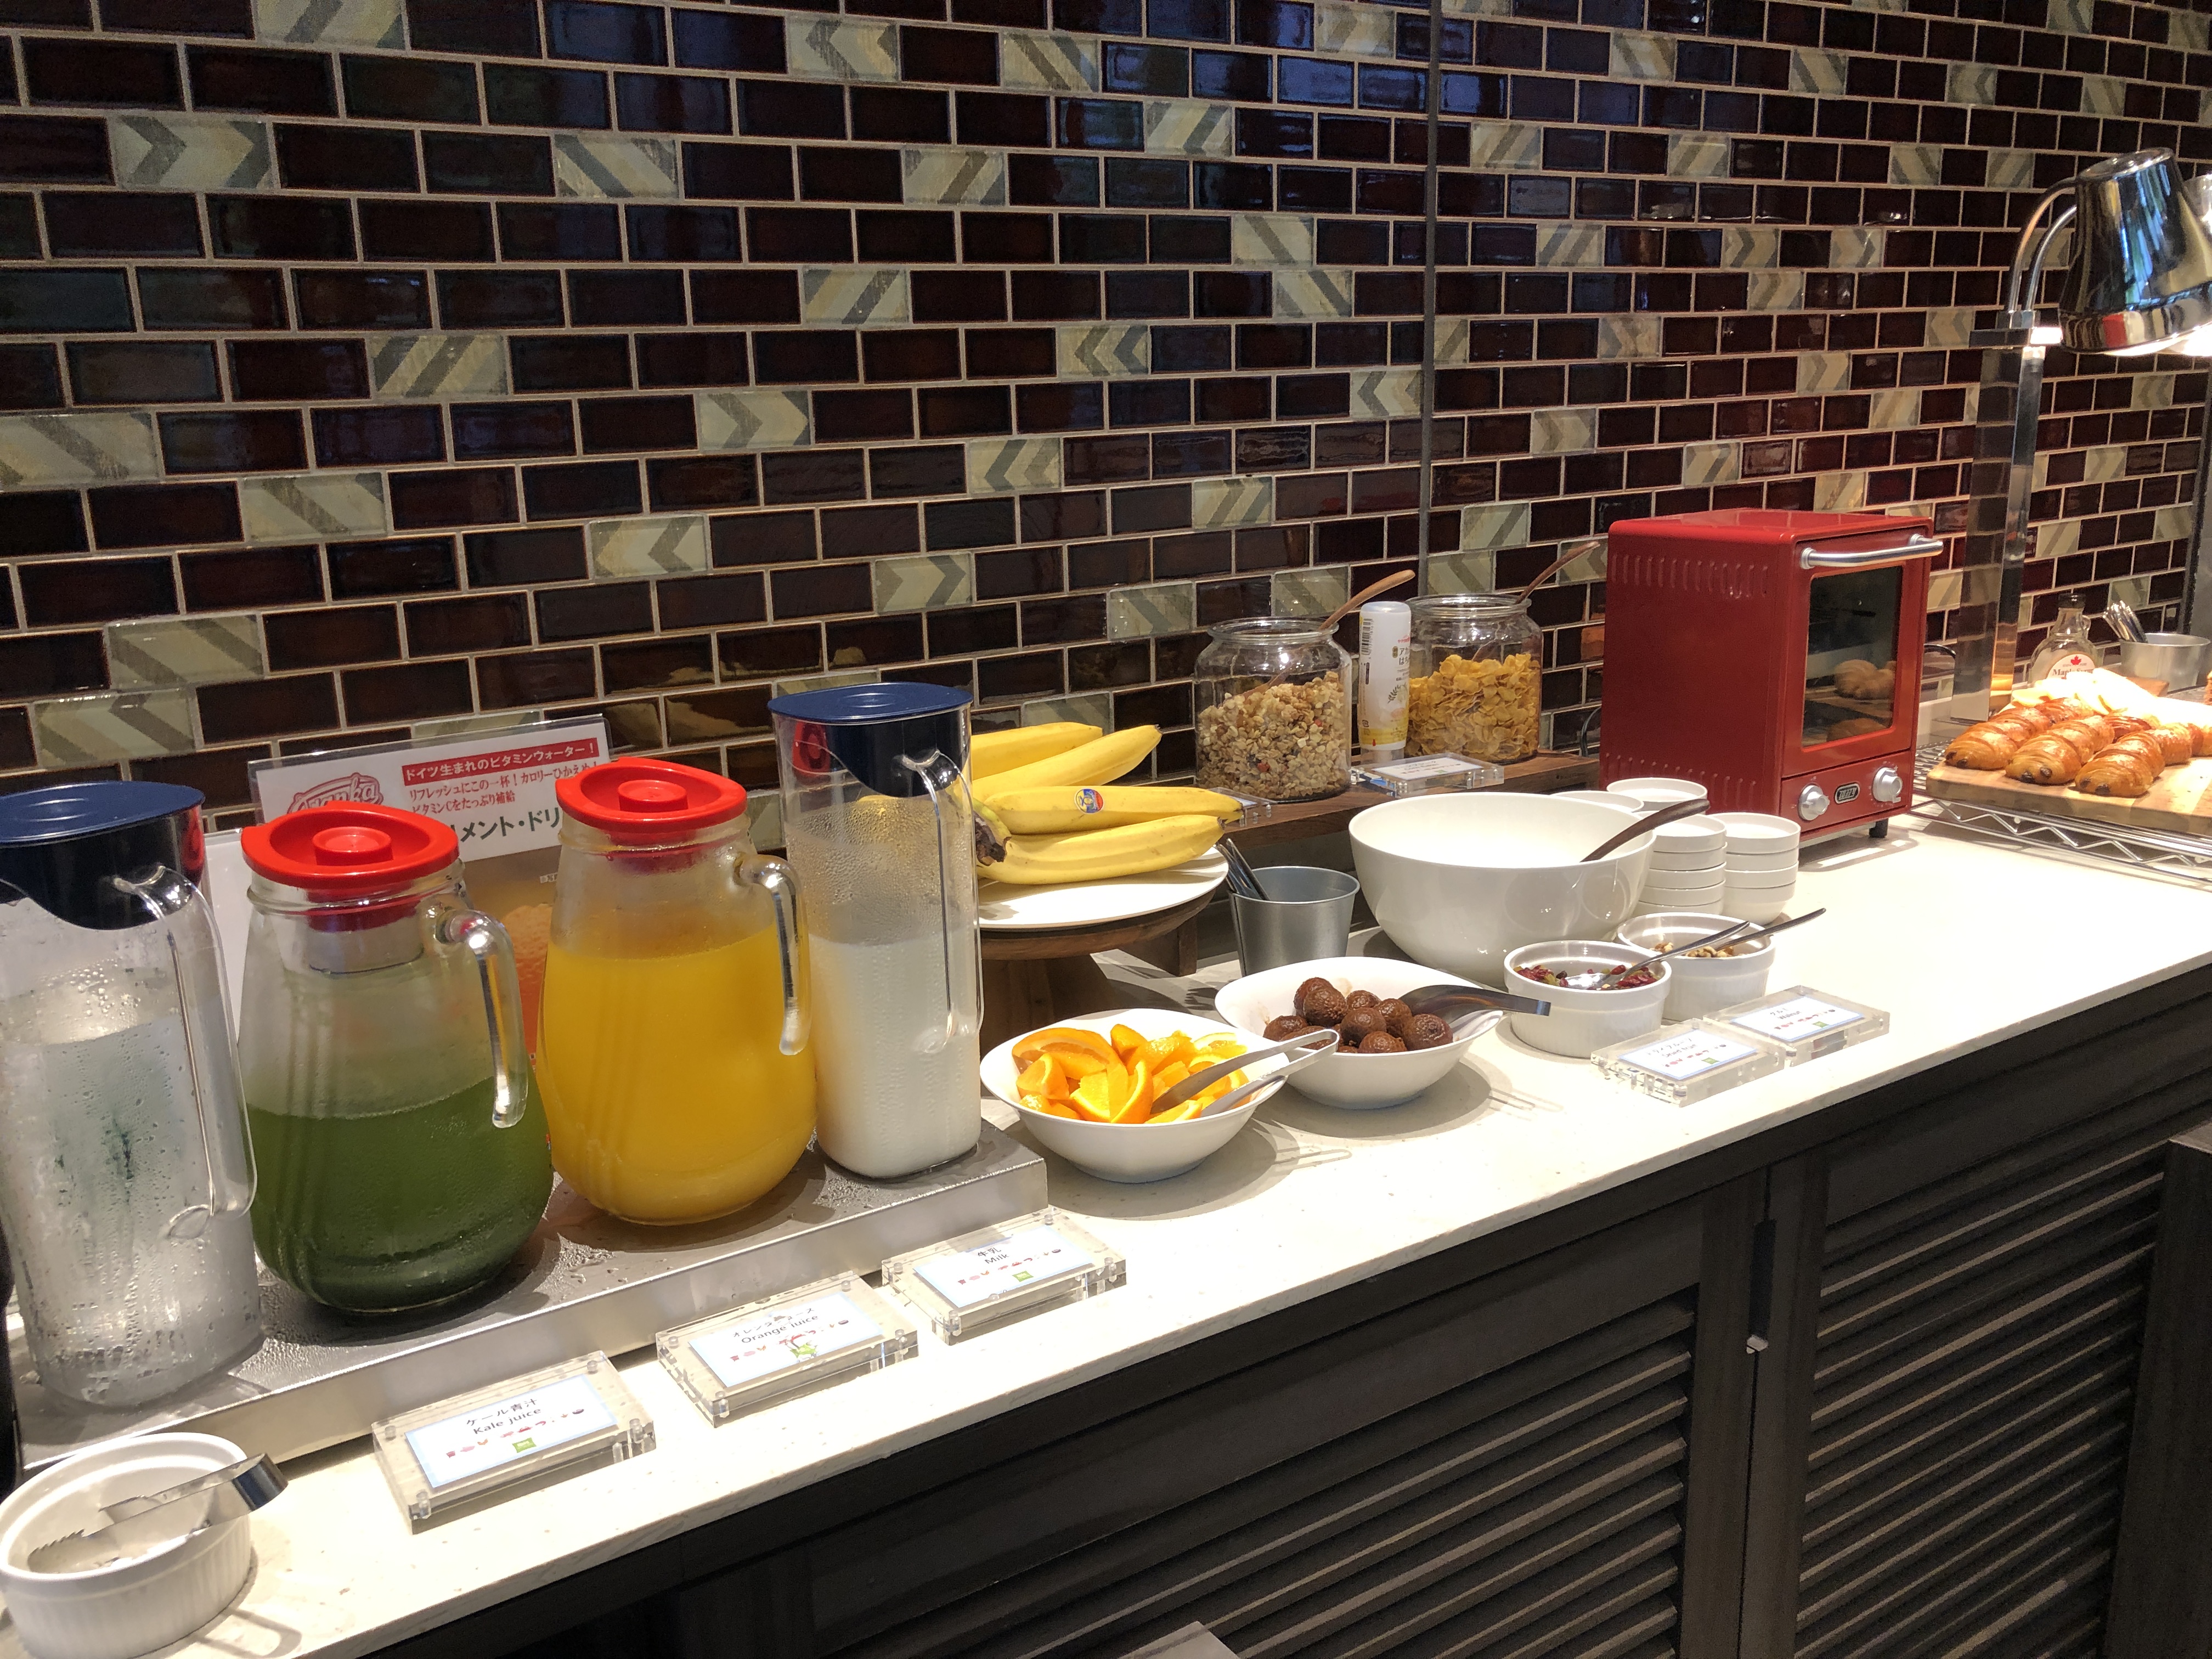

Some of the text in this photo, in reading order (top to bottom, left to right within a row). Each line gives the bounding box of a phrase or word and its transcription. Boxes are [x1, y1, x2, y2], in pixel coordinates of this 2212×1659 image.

[984, 1254, 1009, 1264] Milk
[741, 1325, 787, 1344] Orange
[466, 1398, 538, 1426] ケール青汁
[473, 1408, 541, 1435] Kale juice
